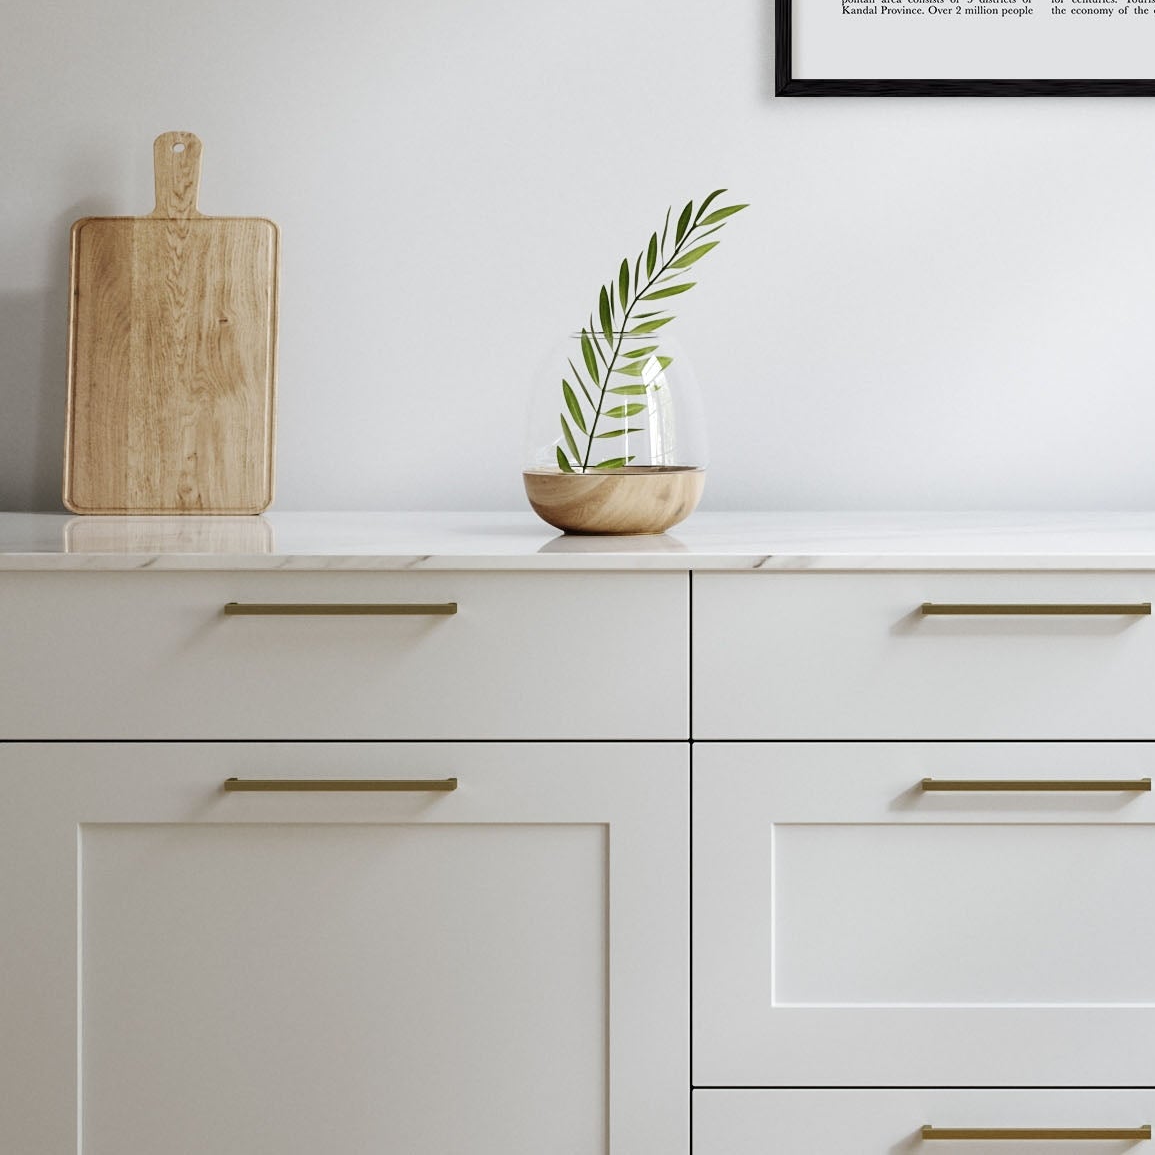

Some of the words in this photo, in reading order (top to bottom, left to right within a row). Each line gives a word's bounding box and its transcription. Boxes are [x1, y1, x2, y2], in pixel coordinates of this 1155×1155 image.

[842, 6, 877, 15] Kandal
[881, 6, 925, 15] Province.
[928, 6, 952, 15] Over
[956, 6, 962, 15] 2
[965, 6, 998, 15] million
[1002, 6, 1033, 17] people
